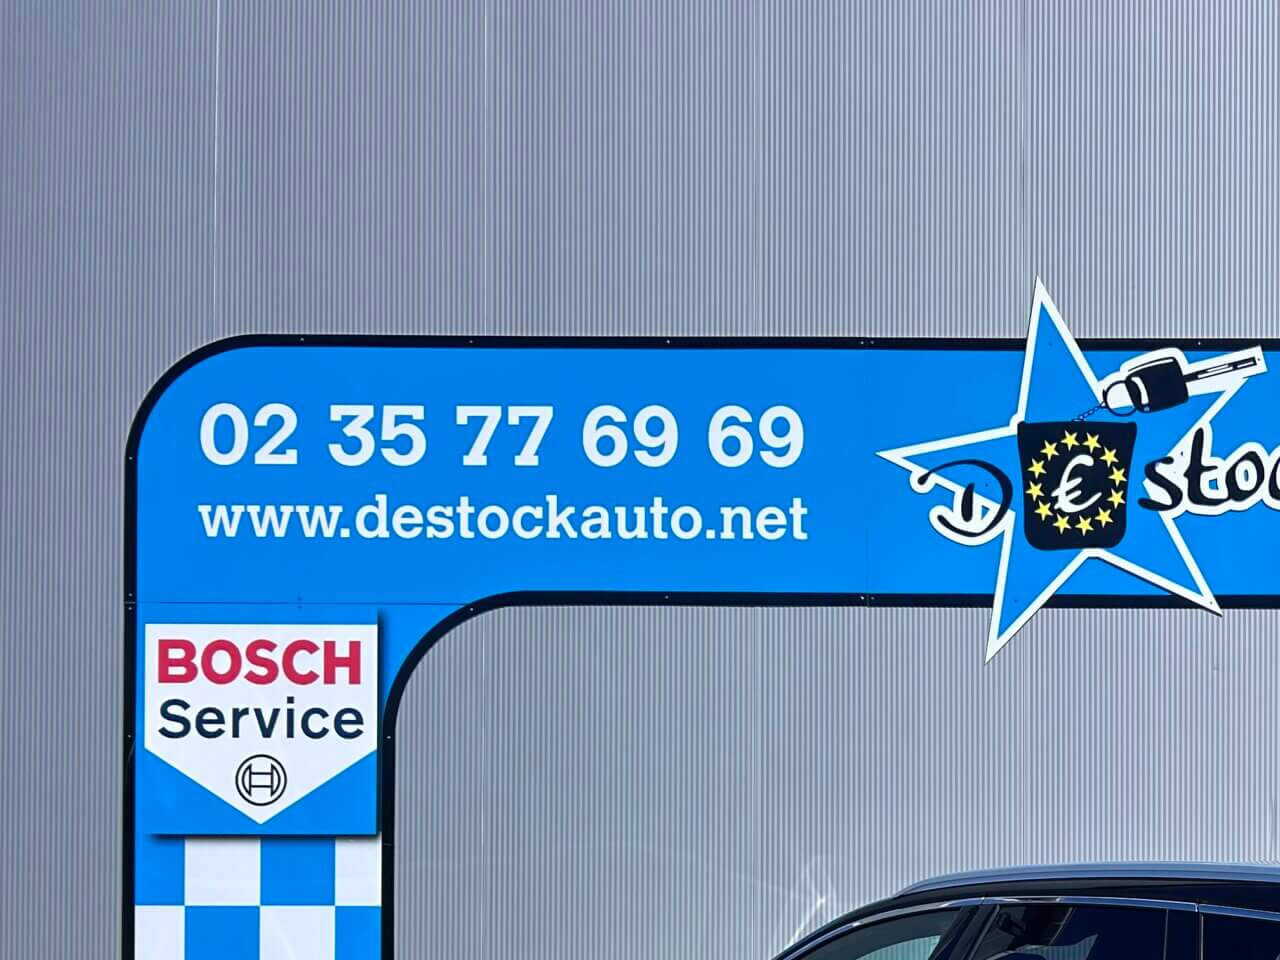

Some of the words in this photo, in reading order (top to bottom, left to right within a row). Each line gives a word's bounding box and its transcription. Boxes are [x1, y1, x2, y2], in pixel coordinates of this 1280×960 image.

[200, 403, 298, 466] 02
[328, 404, 426, 466] 35
[456, 405, 553, 466] 77
[582, 405, 678, 467] 69
[708, 405, 804, 467] 69
[199, 494, 808, 540] www.destockauto.net
[158, 639, 361, 685] BOSCH
[158, 696, 364, 739] Service
